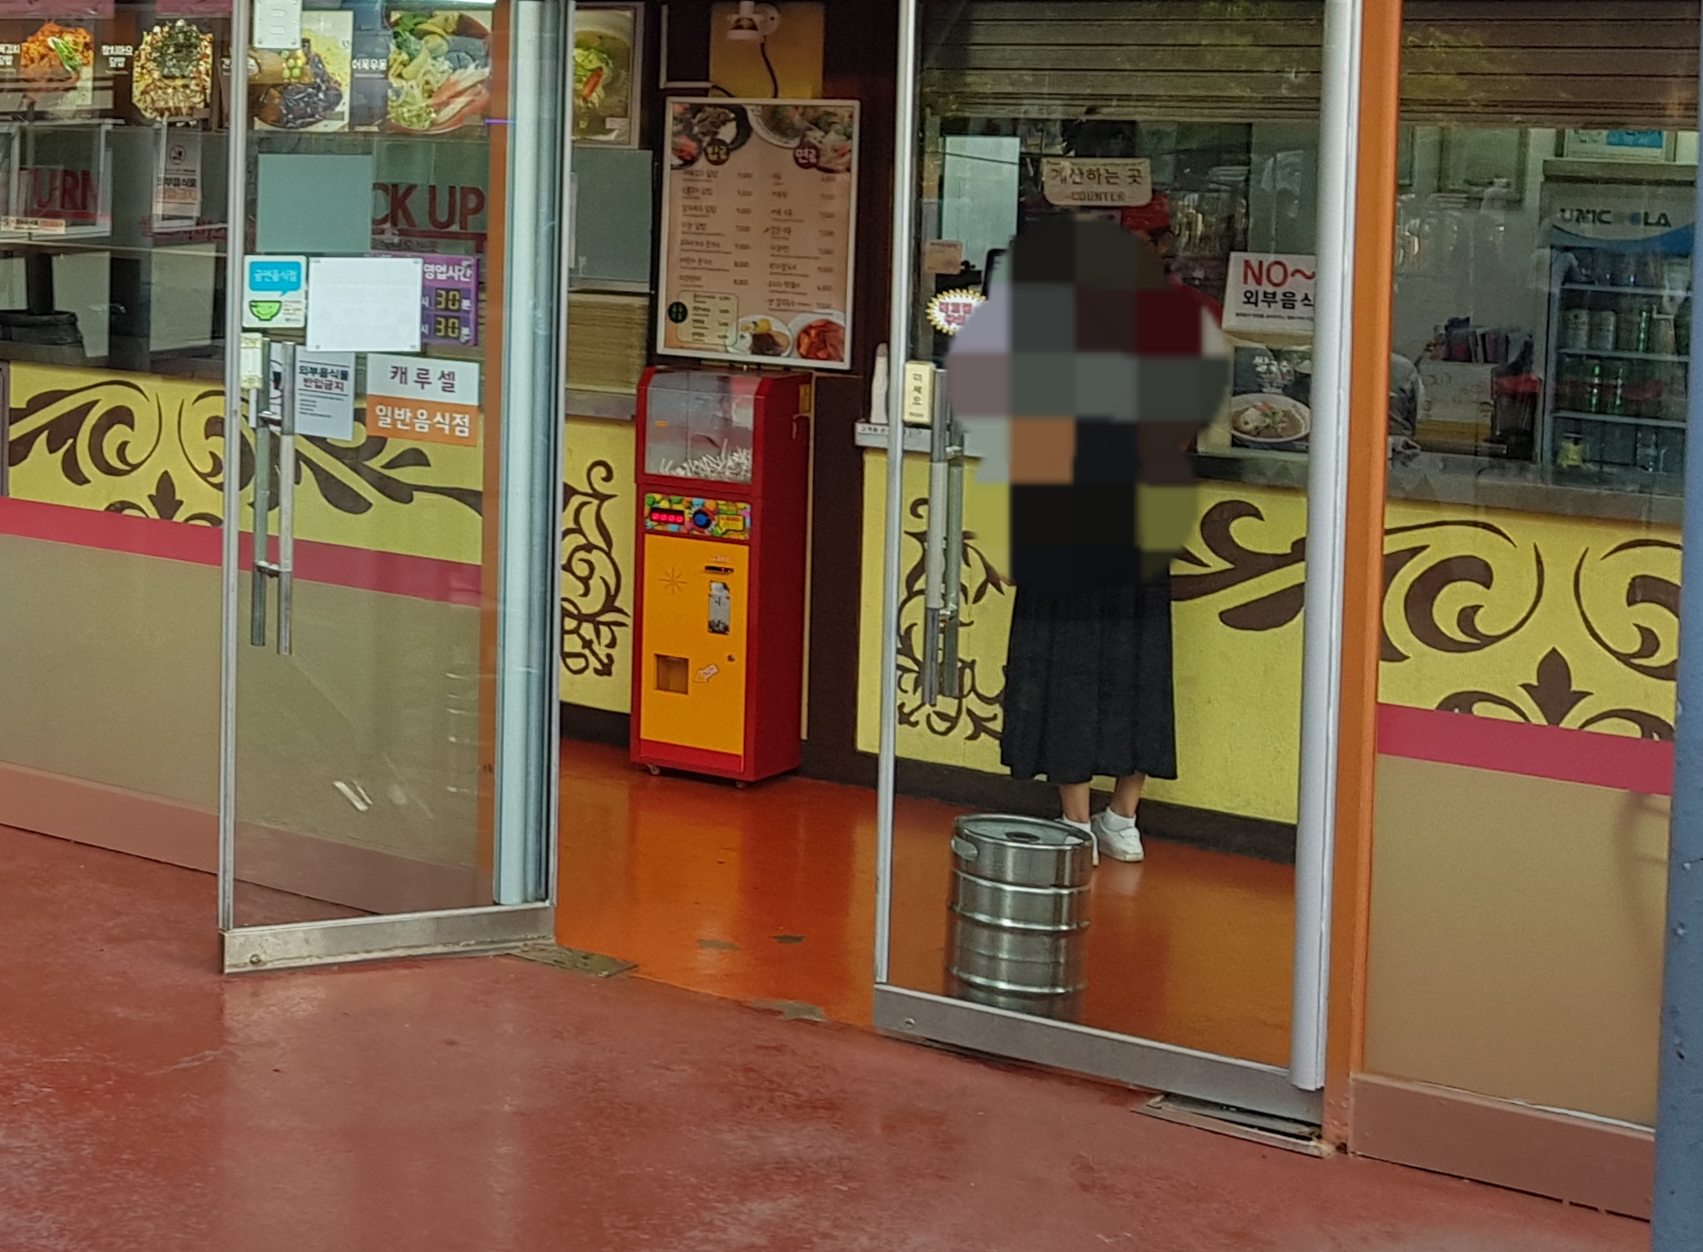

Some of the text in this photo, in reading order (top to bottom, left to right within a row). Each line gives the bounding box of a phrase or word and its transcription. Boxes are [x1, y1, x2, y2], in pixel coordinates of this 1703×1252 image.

[1127, 168, 1143, 185] 곳
[428, 185, 485, 231] UP
[423, 263, 472, 282] 영업시간
[435, 289, 460, 310] 30
[435, 317, 460, 338] 30
[298, 365, 349, 381] 외부음식물
[390, 365, 456, 393] 캐루셀
[375, 404, 471, 438] 일반음식점
